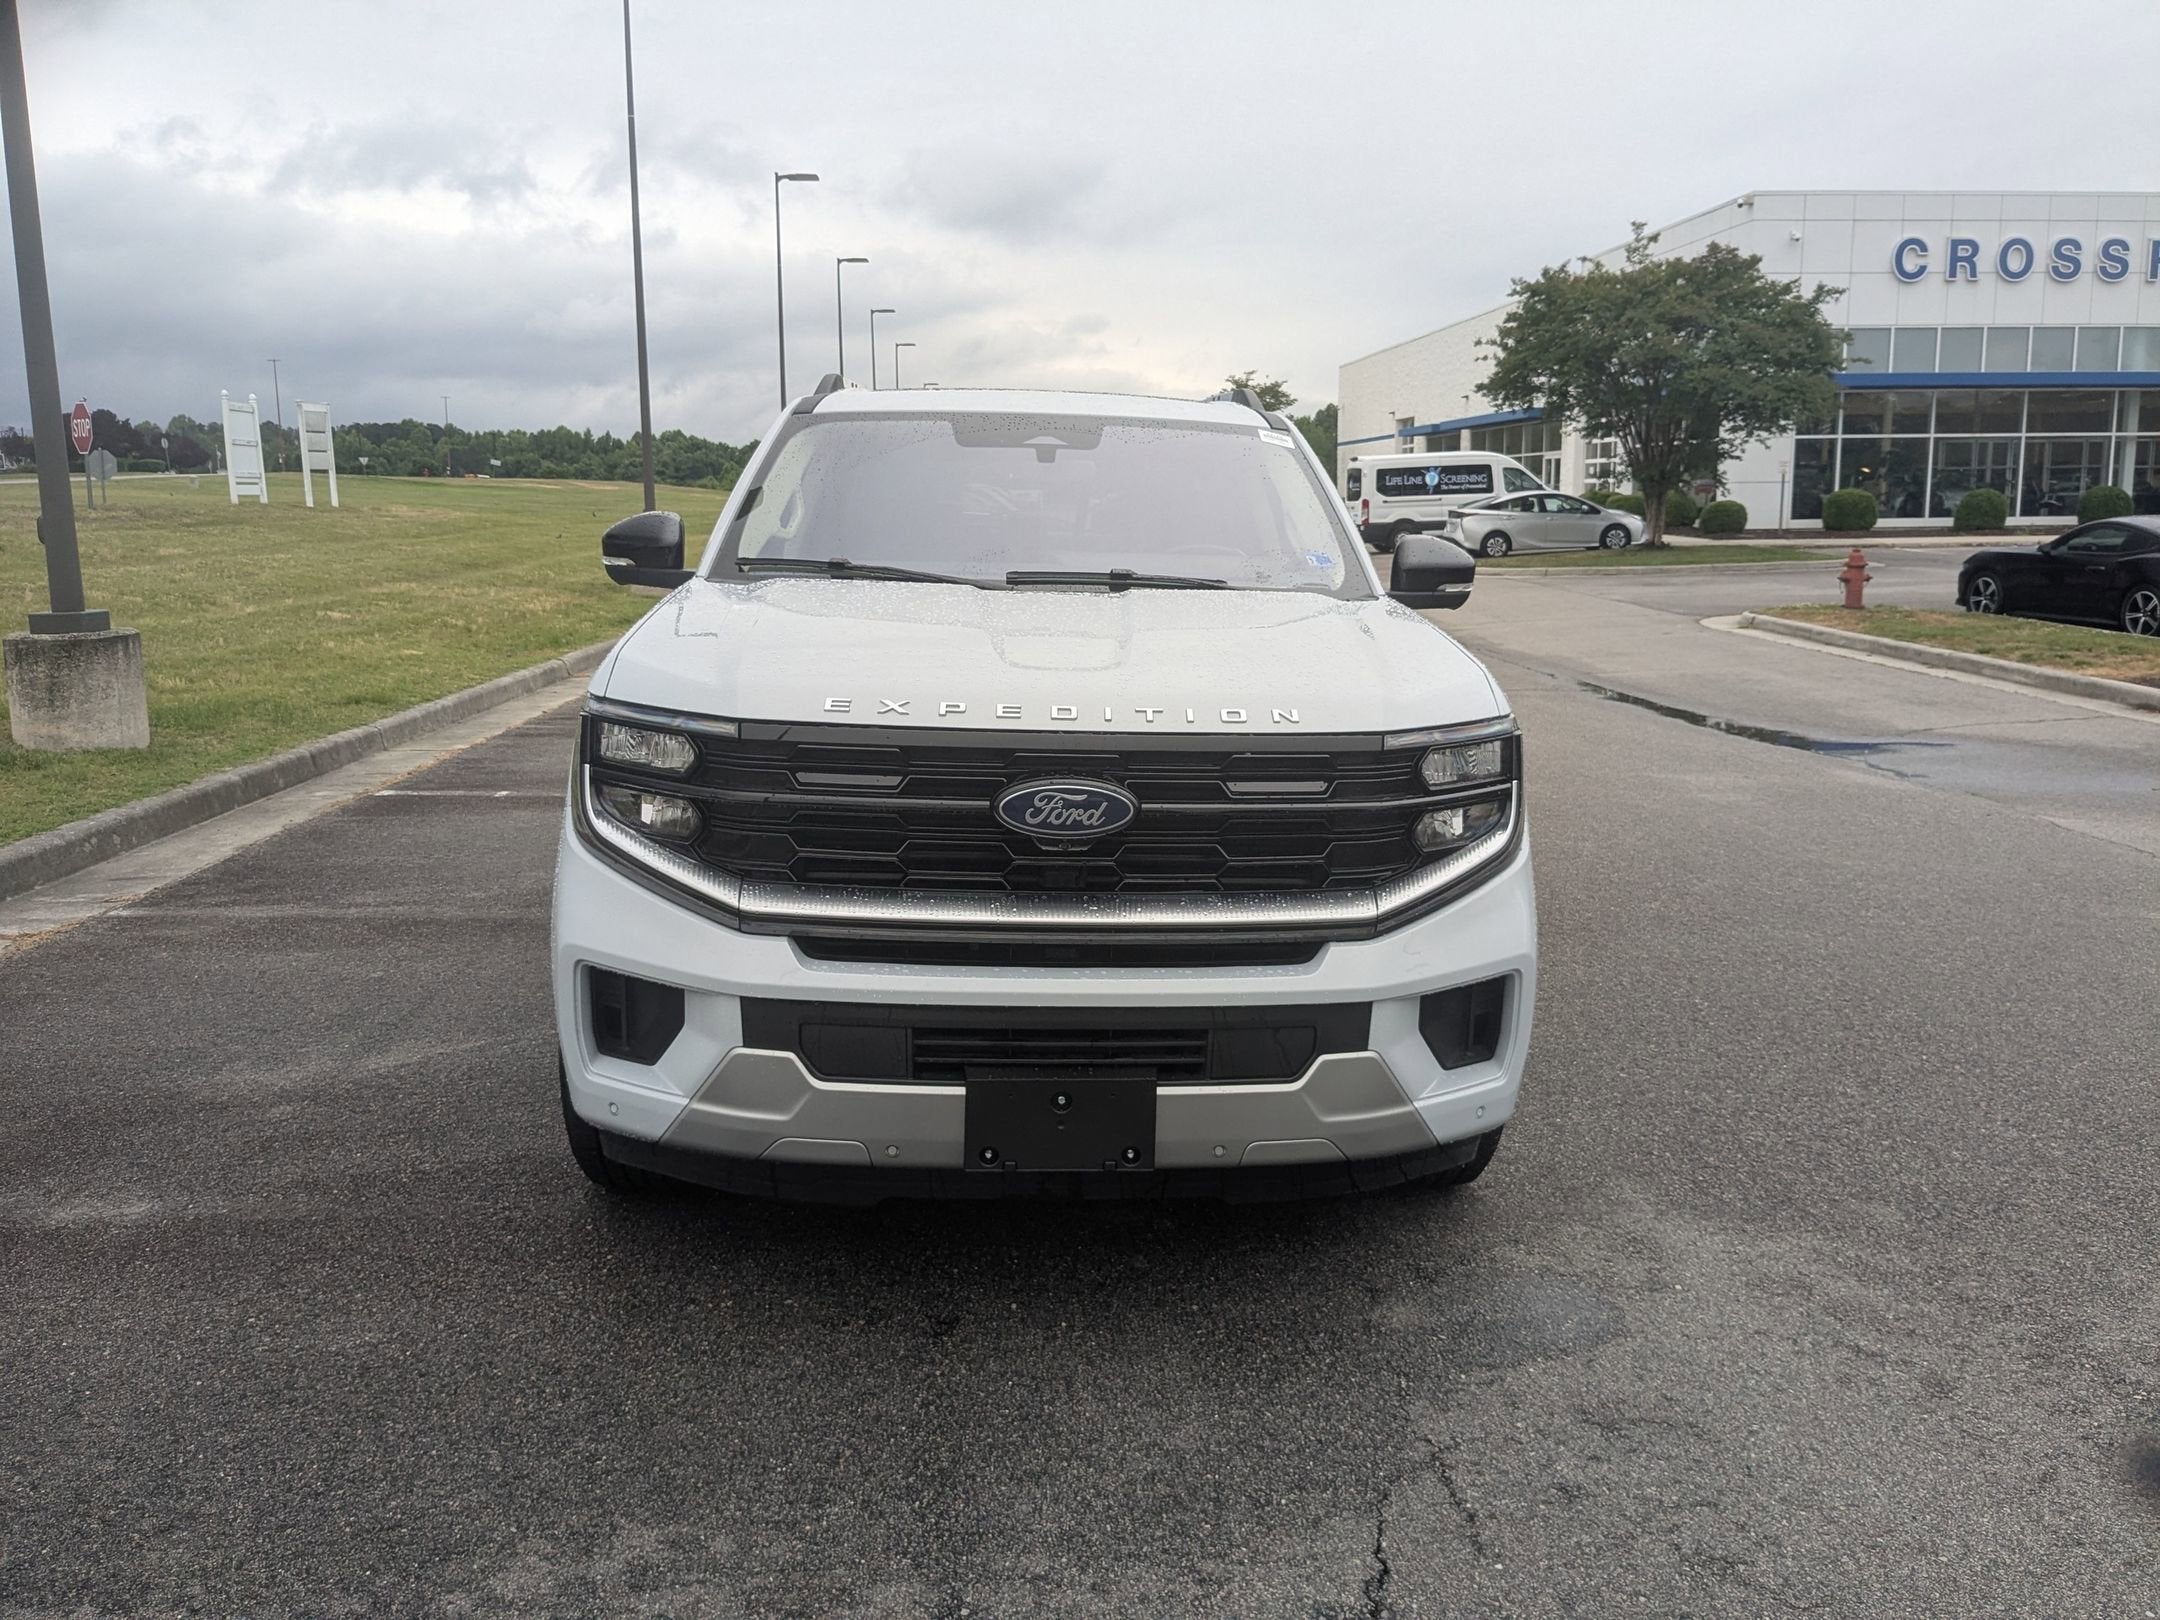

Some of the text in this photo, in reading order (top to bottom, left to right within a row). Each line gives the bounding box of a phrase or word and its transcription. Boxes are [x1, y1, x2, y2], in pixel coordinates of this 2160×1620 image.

[73, 418, 90, 437] STOP
[823, 697, 1301, 723] EXPEDITION
[1024, 791, 1109, 826] Ford
